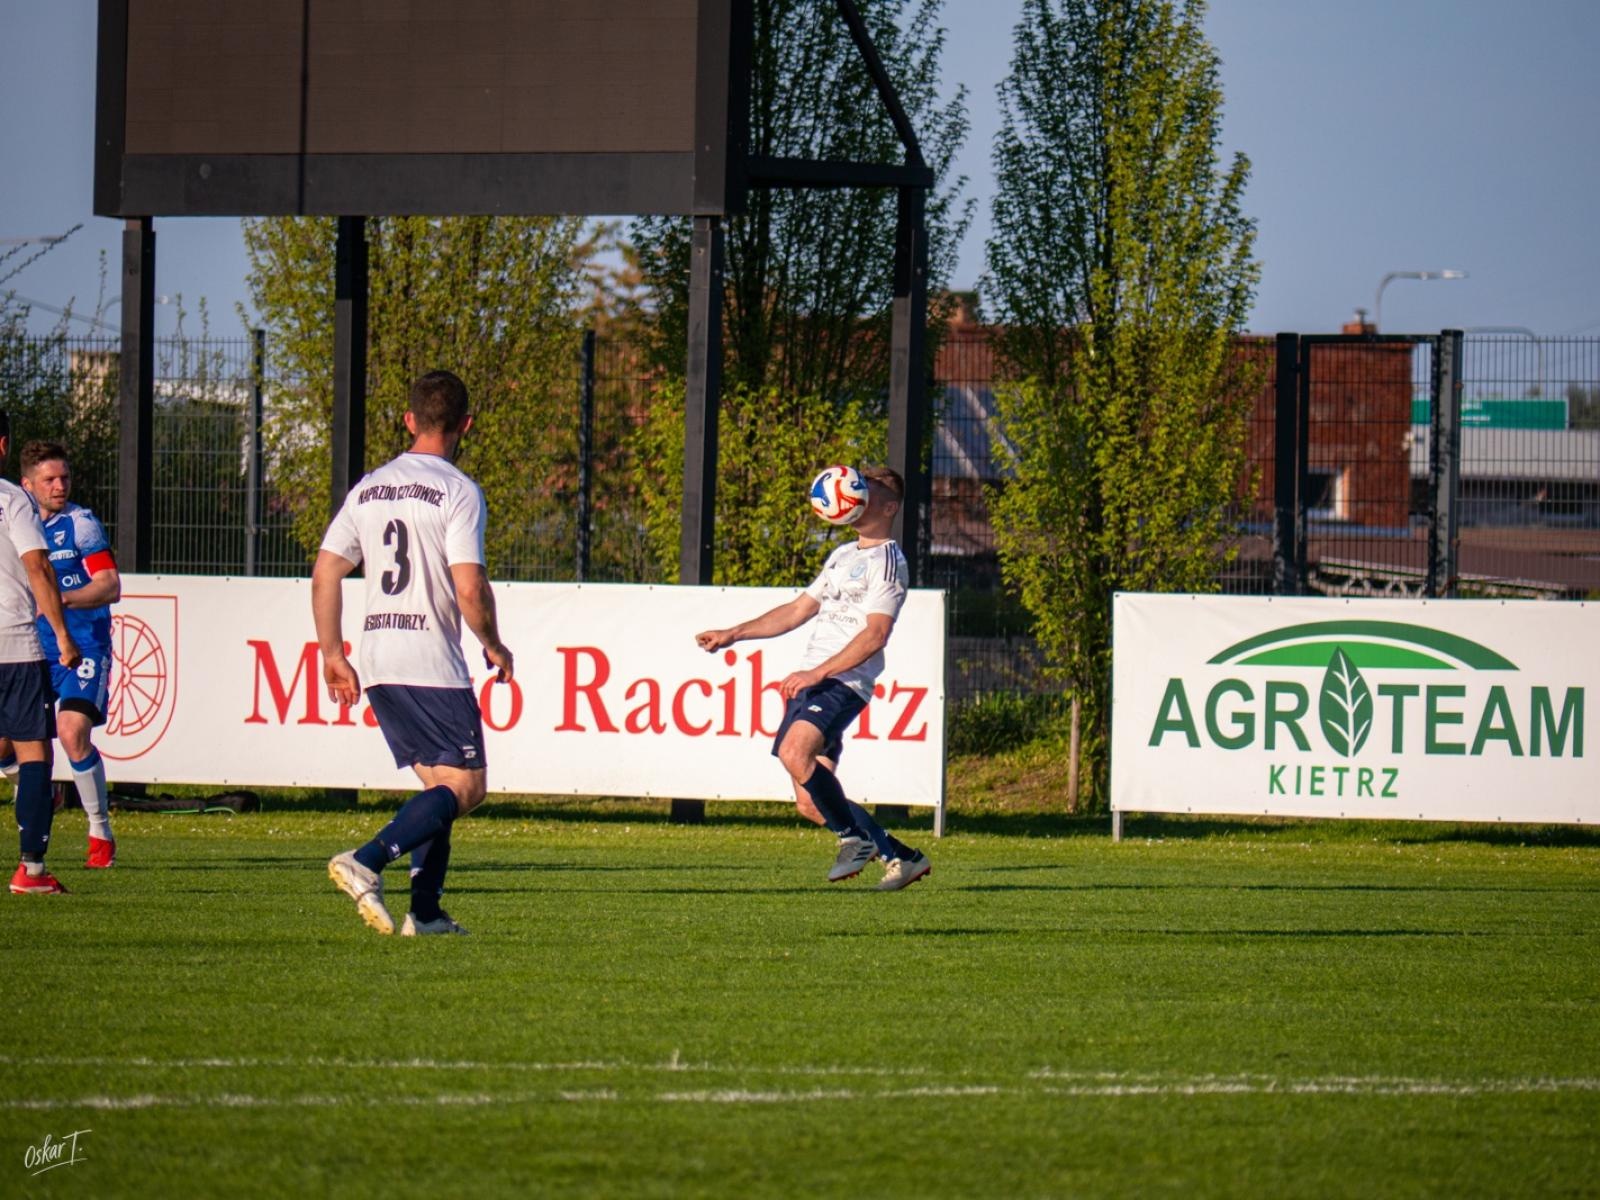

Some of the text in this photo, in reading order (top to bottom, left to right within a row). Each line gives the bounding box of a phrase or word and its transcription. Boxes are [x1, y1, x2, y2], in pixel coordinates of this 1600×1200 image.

[381, 518, 411, 596] 3
[76, 657, 96, 679] 8
[244, 639, 929, 741] Mio Racibrz
[1268, 764, 1399, 798] KIETRZ
